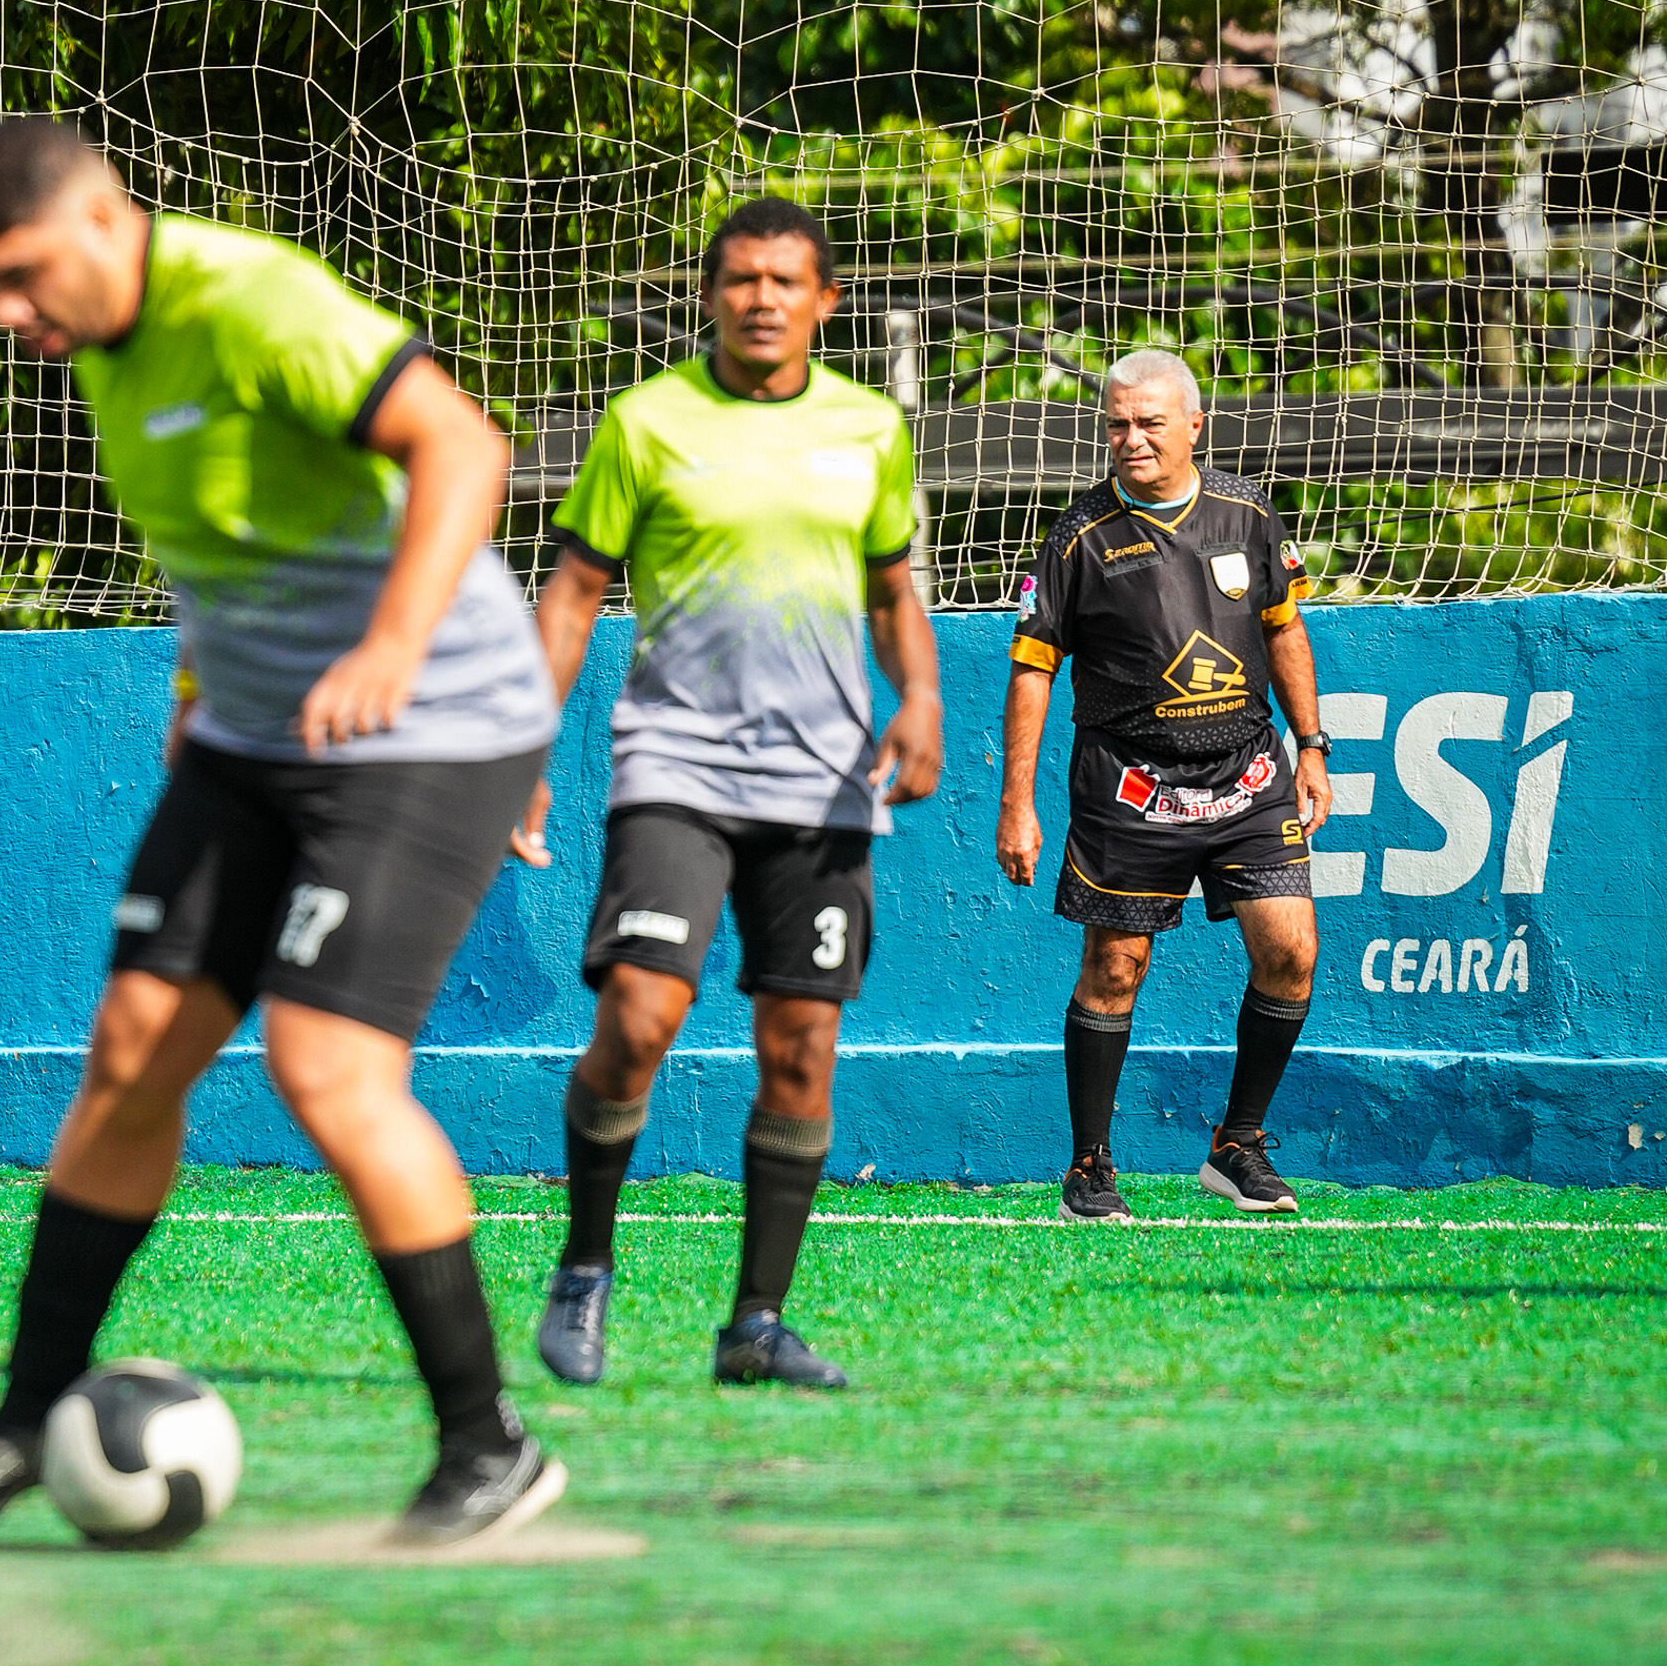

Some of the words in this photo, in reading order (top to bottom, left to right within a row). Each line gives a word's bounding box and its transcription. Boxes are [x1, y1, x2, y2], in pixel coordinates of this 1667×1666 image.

[1155, 698, 1246, 718] Construbem
[1159, 794, 1243, 817] Dinâmica
[812, 906, 848, 969] 3
[1361, 925, 1529, 993] CEARÁ
